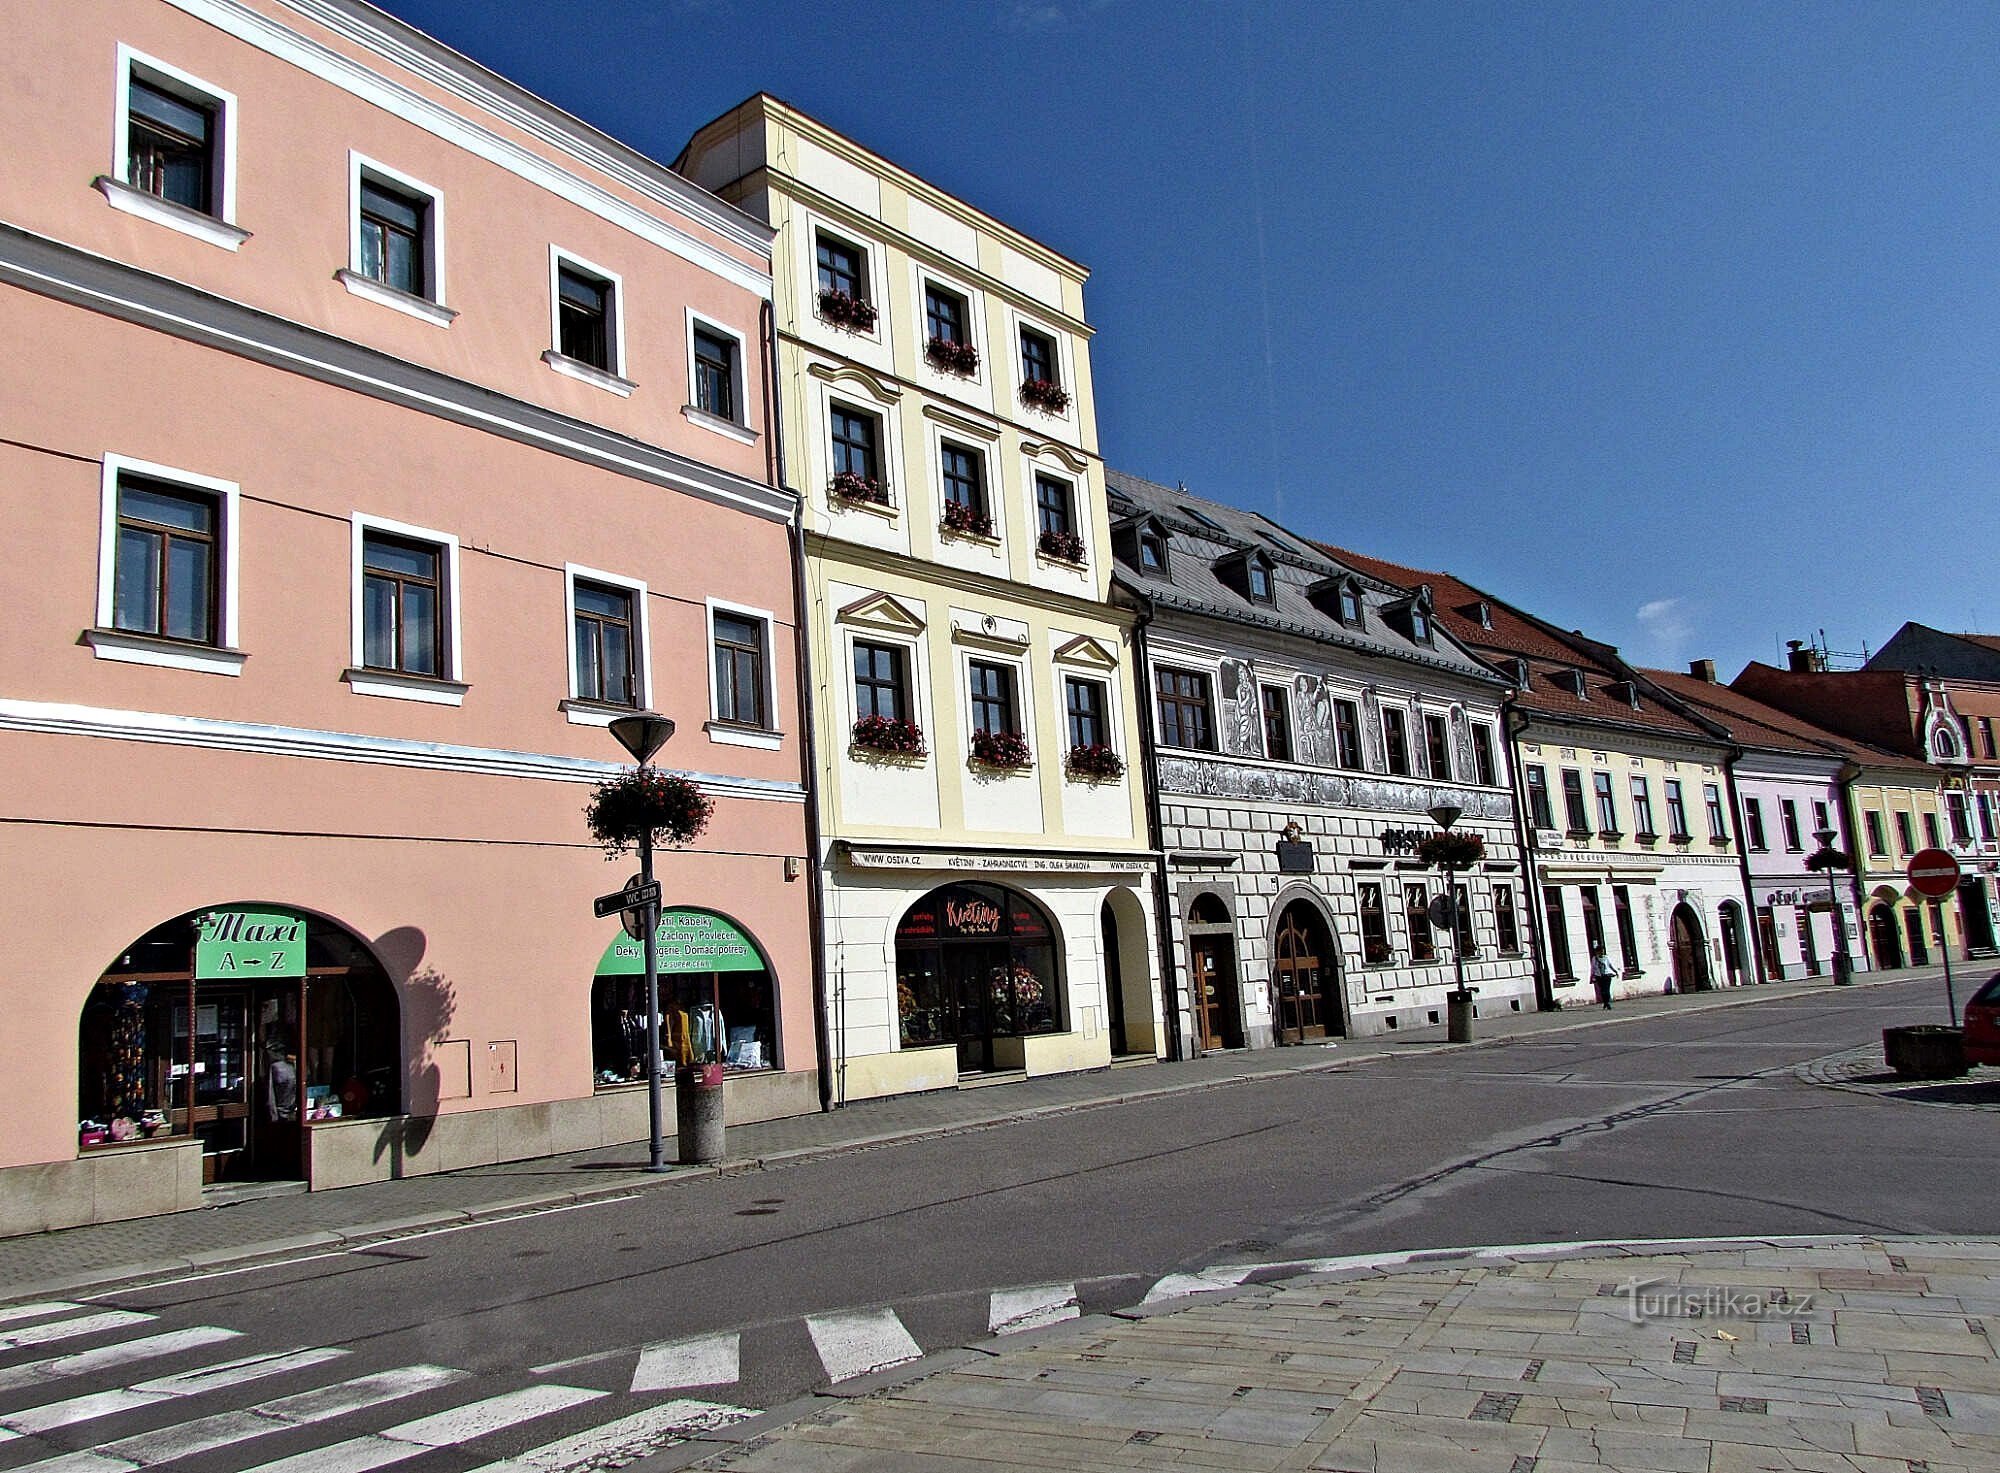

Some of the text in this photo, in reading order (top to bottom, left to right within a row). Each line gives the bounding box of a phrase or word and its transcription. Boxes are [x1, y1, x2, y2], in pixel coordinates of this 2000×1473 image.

[625, 891, 640, 905] WC
[203, 912, 299, 943] Maxi
[946, 900, 1001, 931] Květiny
[220, 952, 285, 970] A Z
